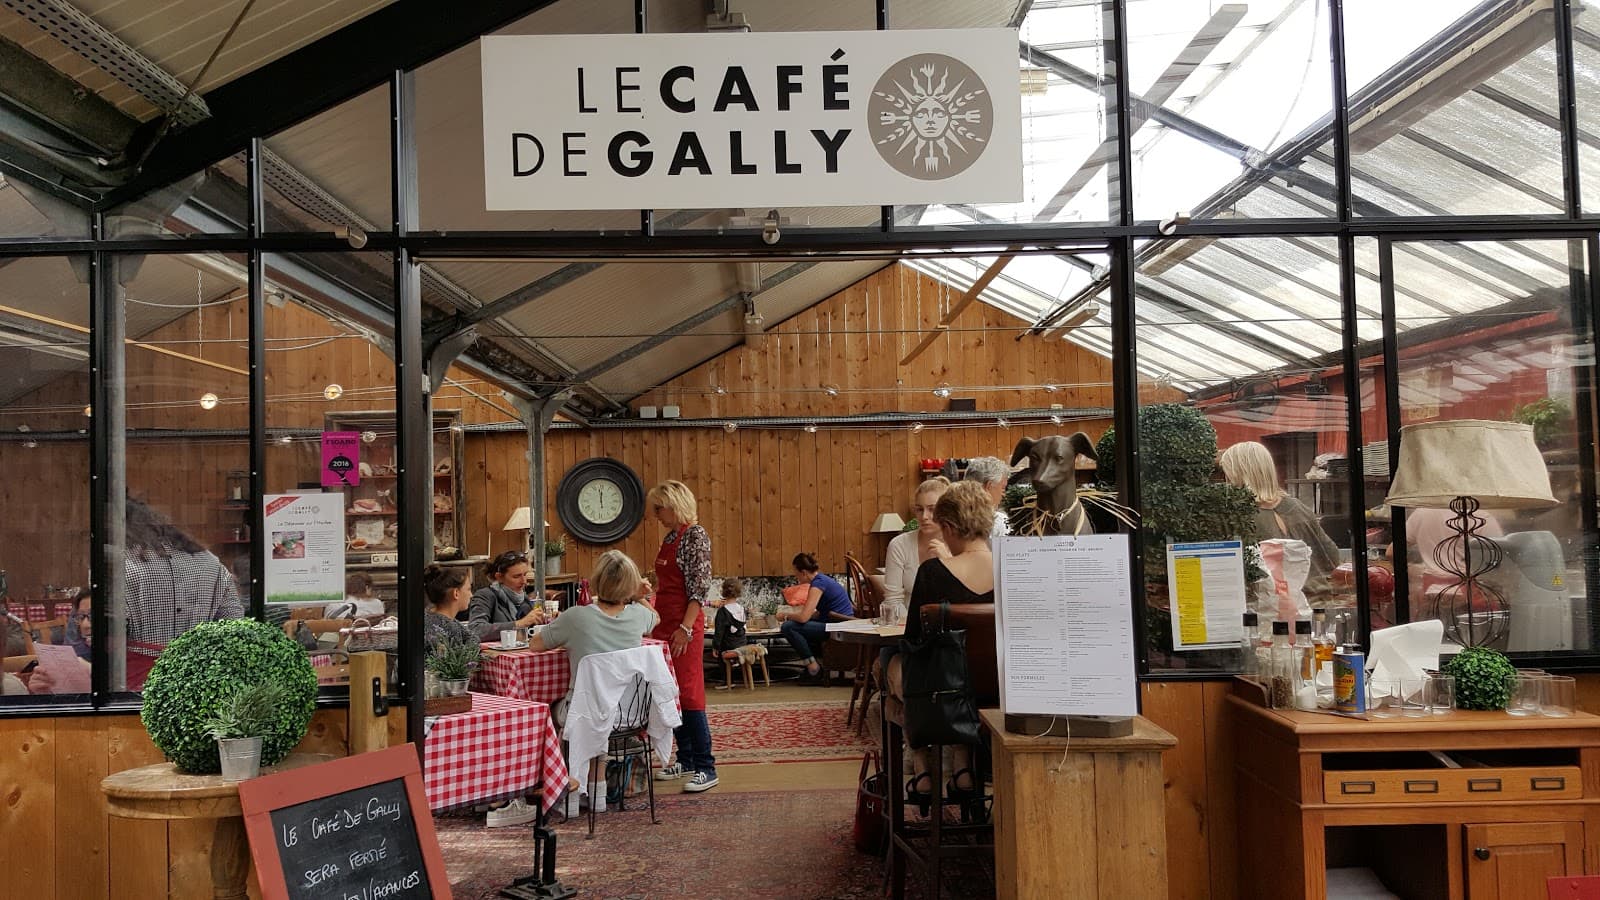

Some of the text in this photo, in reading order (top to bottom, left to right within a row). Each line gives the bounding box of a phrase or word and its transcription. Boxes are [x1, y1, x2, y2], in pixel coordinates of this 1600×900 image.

[284, 824, 298, 848] LE
[343, 809, 363, 829] DE
[304, 838, 387, 888] SERA FERMÉ
